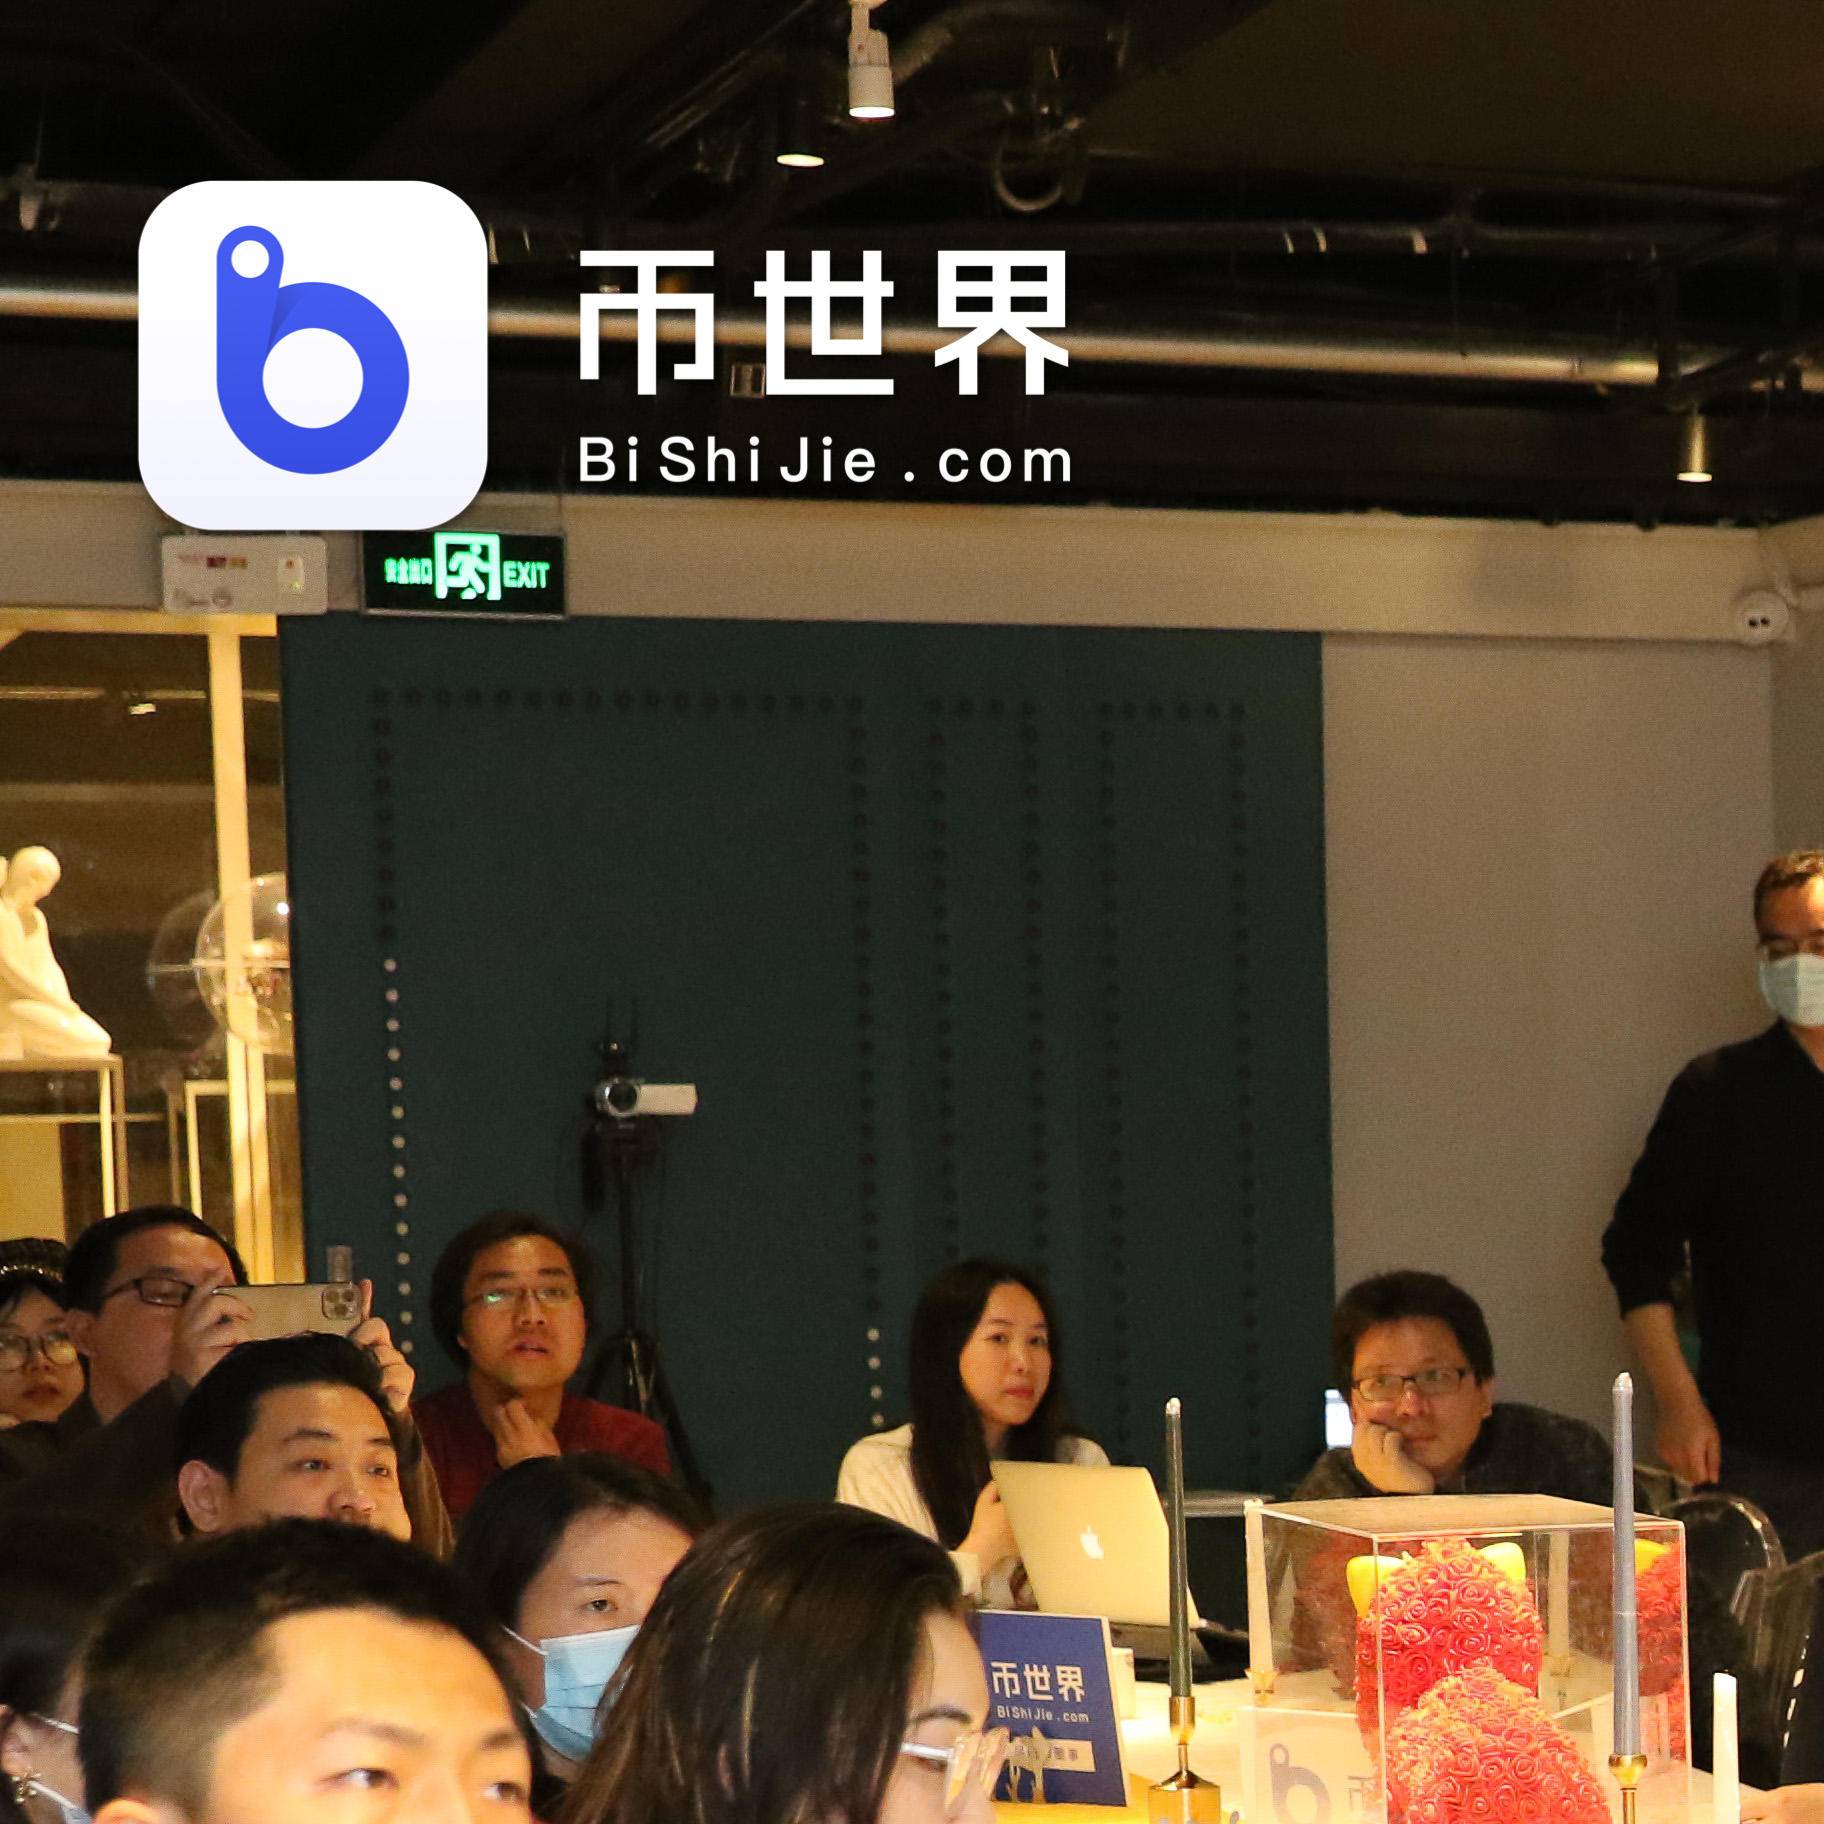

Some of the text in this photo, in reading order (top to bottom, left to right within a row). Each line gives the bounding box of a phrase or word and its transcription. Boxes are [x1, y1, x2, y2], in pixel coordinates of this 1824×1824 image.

[503, 560, 550, 588] EXIT
[990, 1660, 1086, 1703] 币世界
[997, 1704, 1090, 1723] BiShiJie.com
